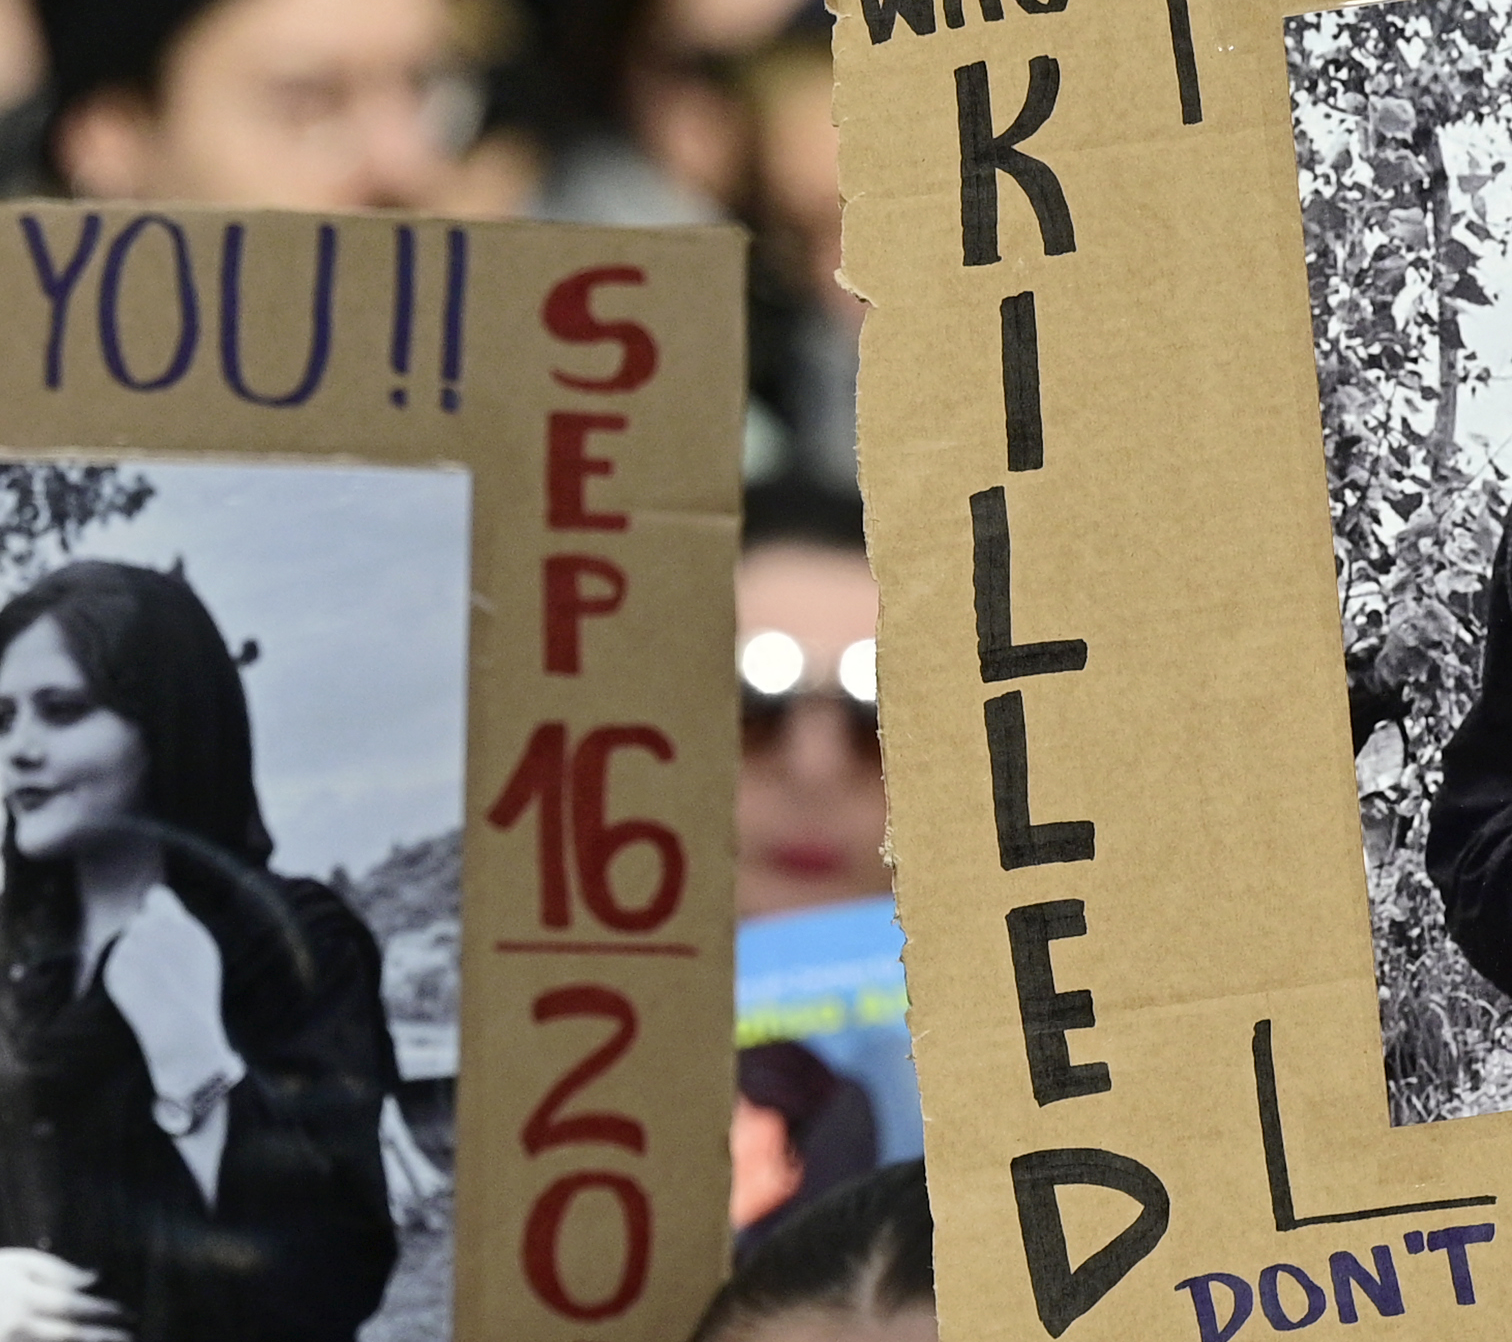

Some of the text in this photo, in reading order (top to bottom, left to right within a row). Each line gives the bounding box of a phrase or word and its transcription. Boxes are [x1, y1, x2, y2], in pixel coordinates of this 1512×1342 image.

[540, 264, 660, 678] SEP
[487, 721, 687, 935] 16
[954, 54, 1171, 1339] KILLED
